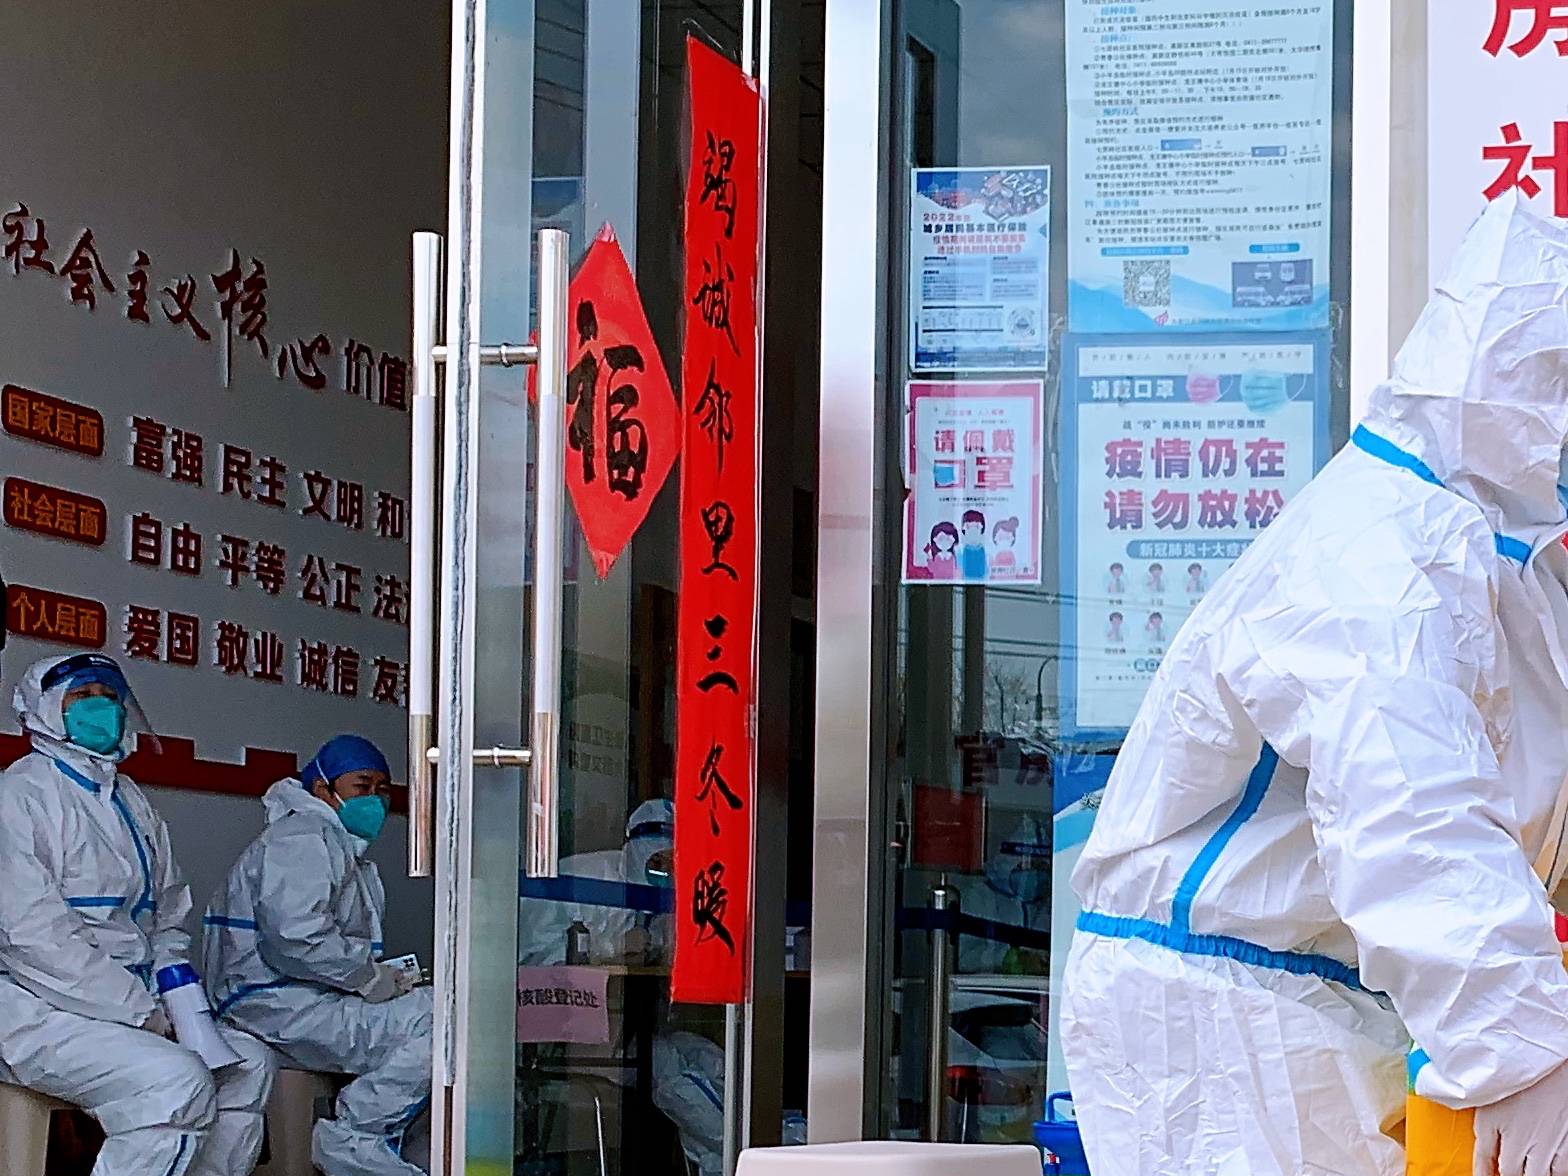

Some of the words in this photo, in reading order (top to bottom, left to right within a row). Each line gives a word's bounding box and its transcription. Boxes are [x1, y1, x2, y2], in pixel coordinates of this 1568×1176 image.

[566, 299, 649, 501] 福
[1091, 379, 1174, 399] 请戴口罩
[7, 393, 99, 451] 国家层面
[130, 415, 203, 486] 富强
[220, 443, 287, 508] 民主
[302, 469, 364, 531] 文明
[376, 490, 410, 542] 和
[1104, 437, 1287, 480] 疫情仍在
[10, 487, 100, 541] 社会层面
[1103, 488, 1285, 531] 请勿放松
[130, 513, 201, 576] 自由
[218, 534, 287, 597] 平等
[300, 553, 362, 615] 公正
[373, 574, 410, 627] 法
[11, 591, 100, 642] 个人层面
[125, 604, 200, 668] 爱国
[215, 620, 285, 685] 敬业
[300, 638, 361, 700] 诚信
[373, 655, 410, 707] 友
